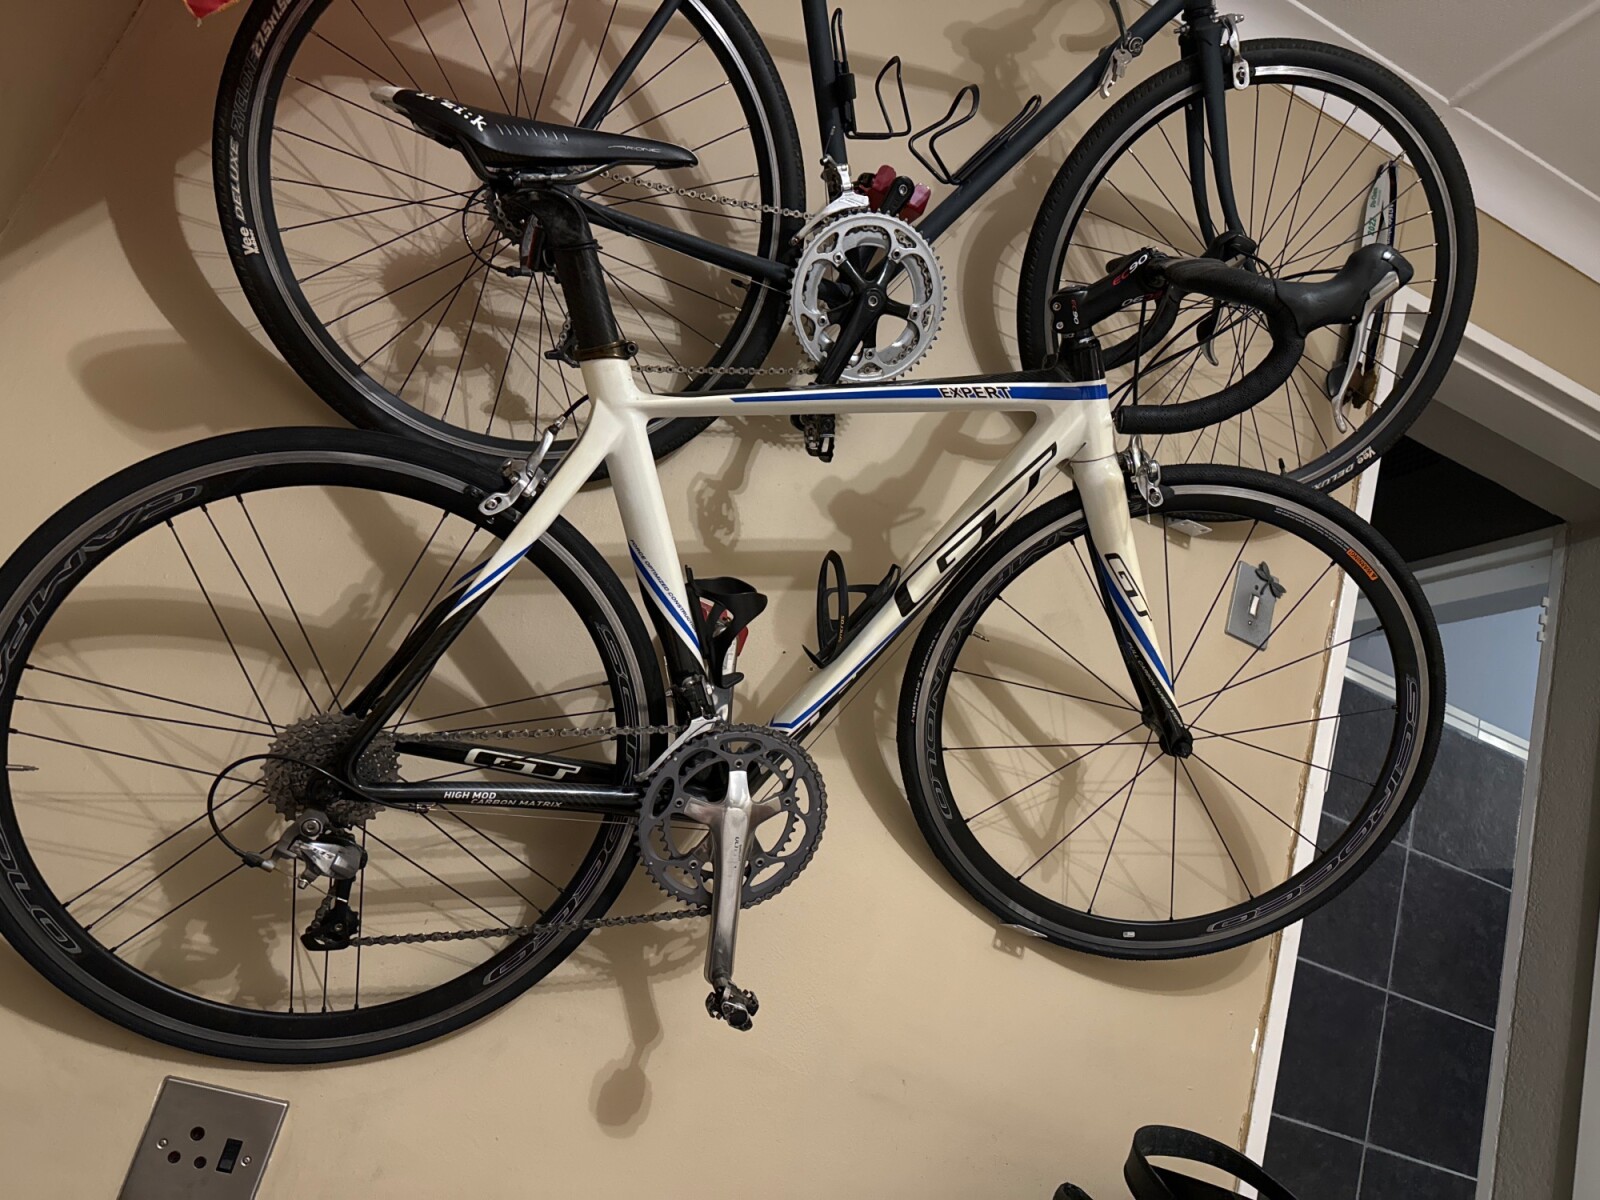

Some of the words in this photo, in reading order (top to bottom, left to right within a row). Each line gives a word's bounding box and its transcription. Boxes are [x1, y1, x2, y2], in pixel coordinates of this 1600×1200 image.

[251, 0, 293, 58] 27.5x1.5
[230, 135, 246, 224] DELUXE
[240, 226, 256, 256] Vee
[1111, 254, 1148, 286] EC90
[1071, 299, 1080, 325] EC90
[939, 385, 1013, 399] EXPERT
[1312, 462, 1355, 490] DELUX
[894, 441, 1058, 617] GT
[630, 539, 646, 560] FORCE
[644, 560, 670, 592] OPTIMIZED
[1104, 553, 1153, 622] GT
[1127, 641, 1139, 659] FULL
[1137, 660, 1157, 688] CARBON
[463, 747, 581, 781] GT
[443, 791, 470, 800] HIGH
[472, 791, 497, 800] MOD
[470, 798, 516, 806] CARBON
[518, 800, 563, 809] MATRIX
